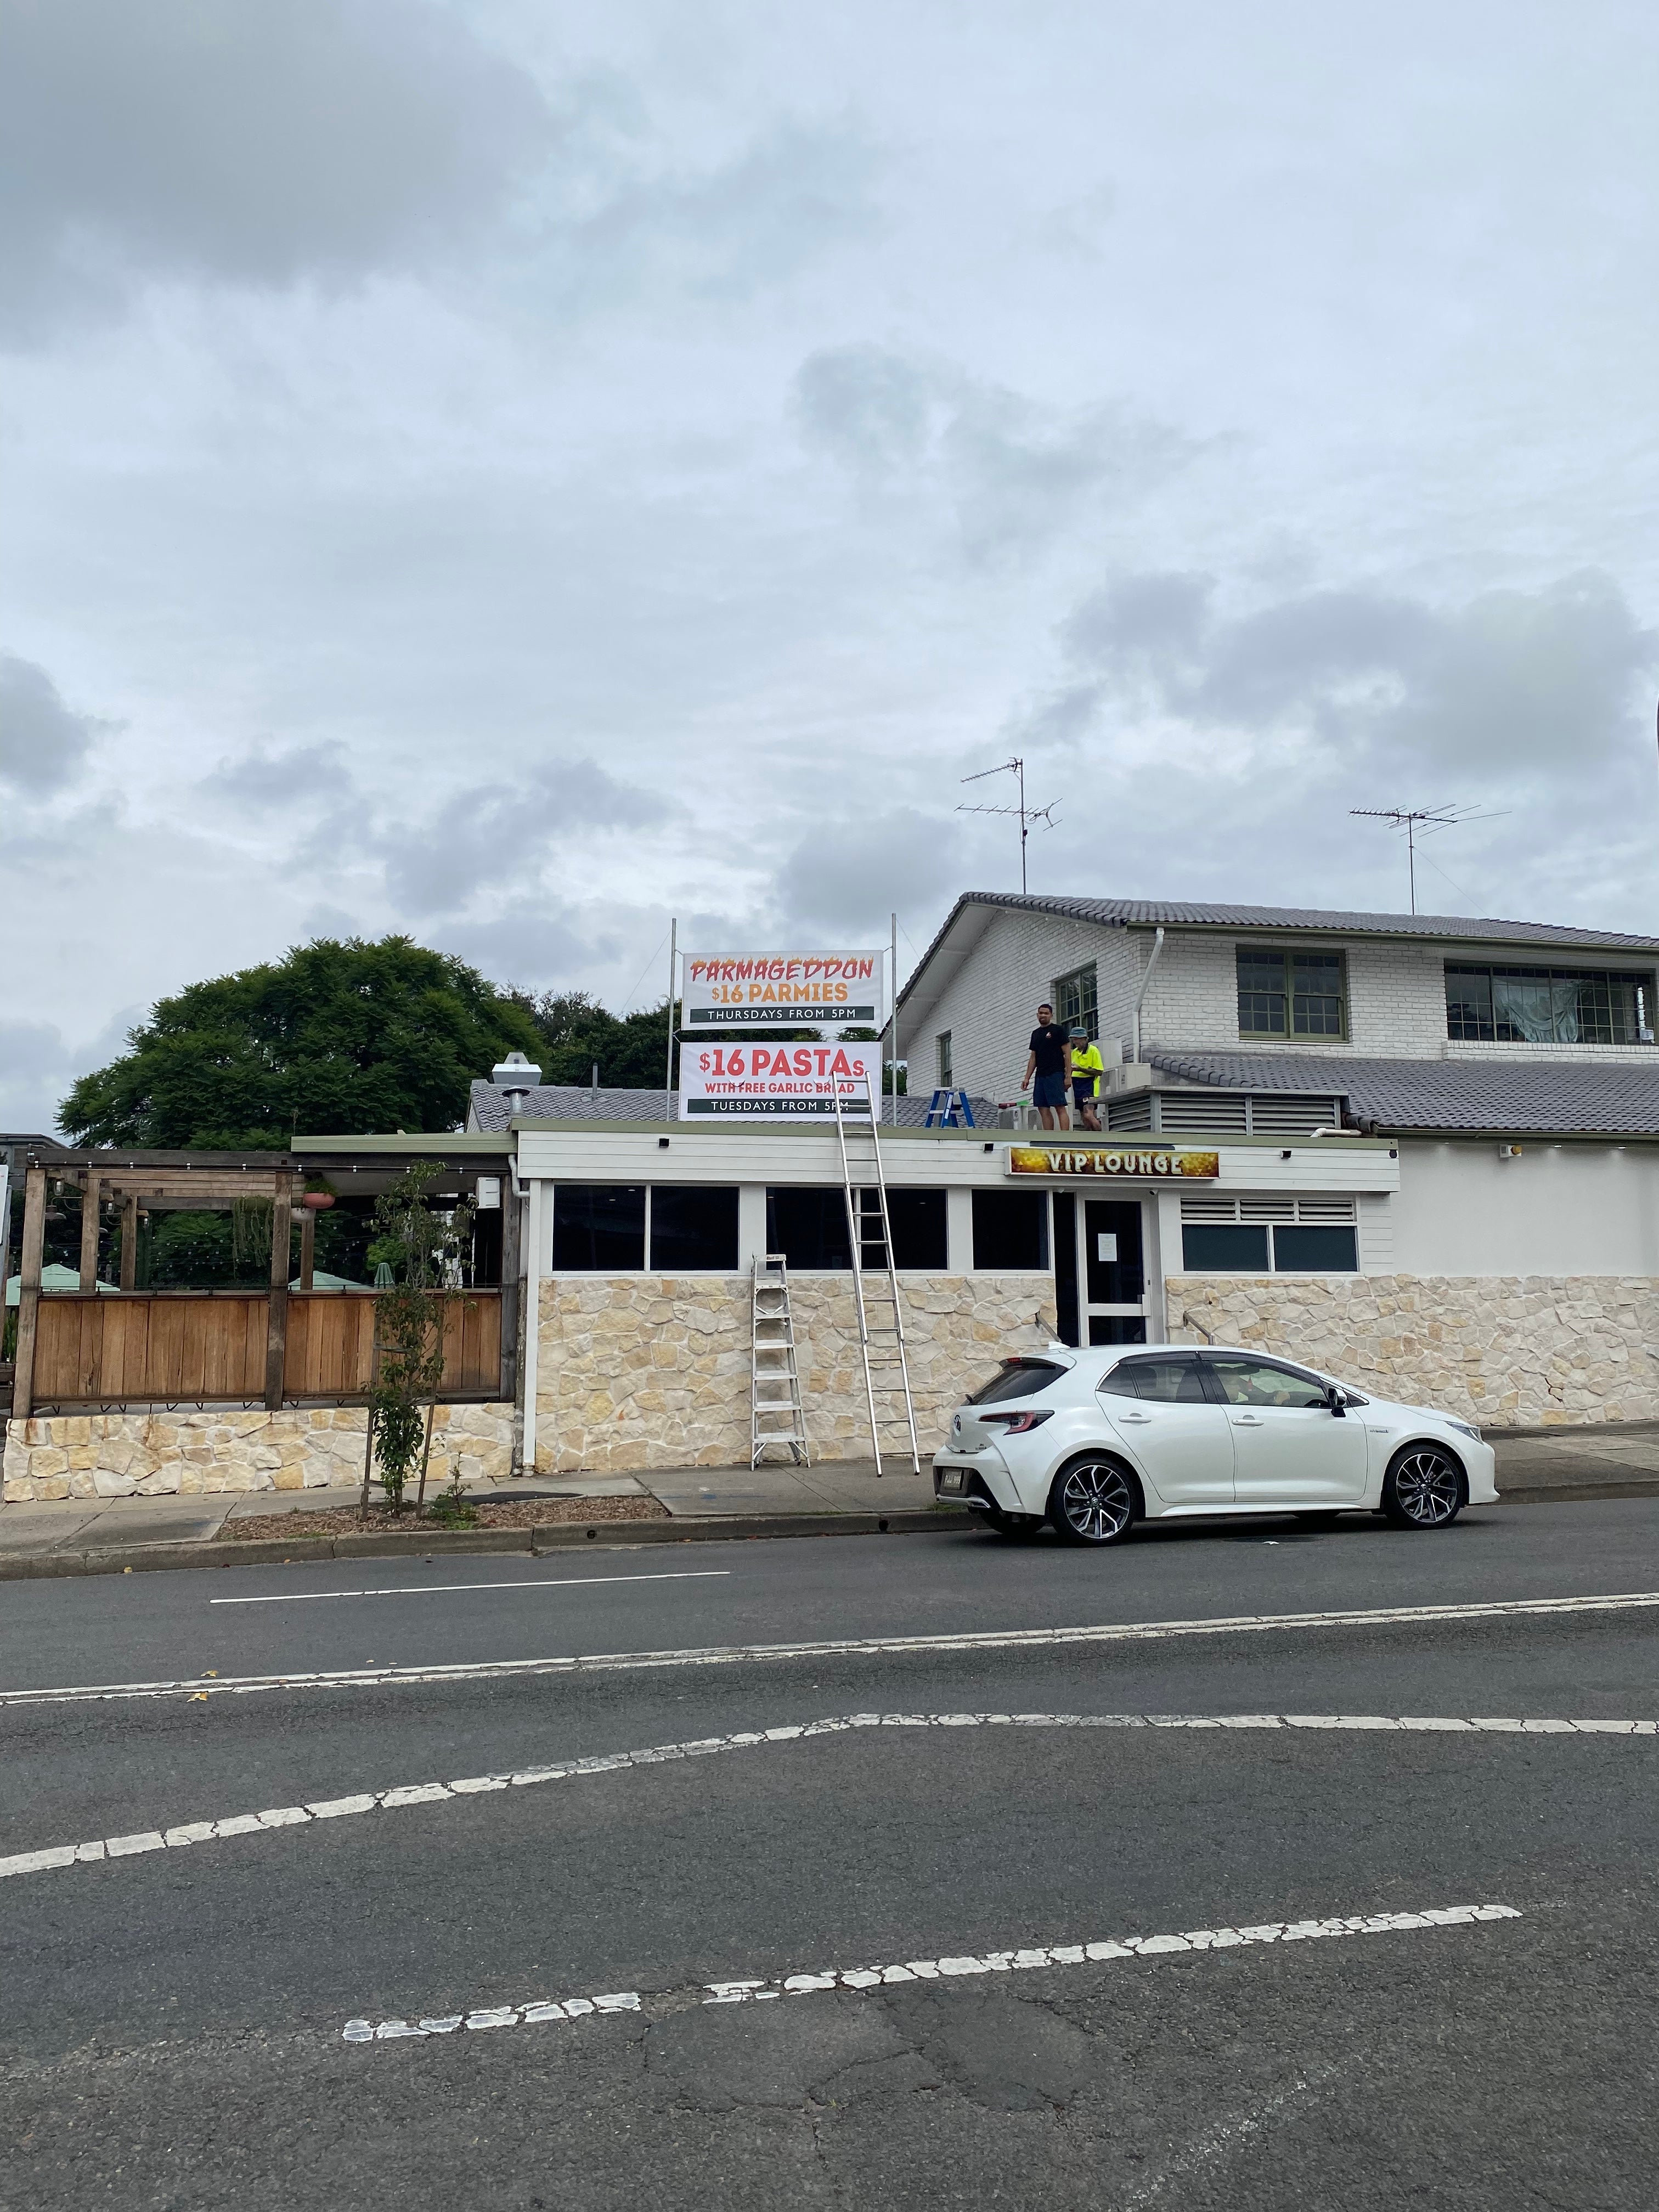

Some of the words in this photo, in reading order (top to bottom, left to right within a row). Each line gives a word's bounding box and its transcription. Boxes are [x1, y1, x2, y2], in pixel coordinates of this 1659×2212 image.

[690, 956, 873, 981] PARMAGEDDON
[712, 985, 743, 1003] $16
[749, 983, 848, 1002] PARMIES
[708, 1009, 783, 1020] THURSDAYS
[789, 1009, 824, 1018] FROM
[831, 1009, 856, 1018] 5PM
[699, 1049, 745, 1076] $16
[705, 1082, 735, 1093] WITH
[738, 1082, 765, 1093] FREE
[768, 1082, 813, 1093] GARLIC
[816, 1082, 855, 1093] BRAD
[710, 1101, 776, 1111] TUESDAYS
[782, 1101, 817, 1111] FROM
[1048, 1152, 1089, 1172] VIP
[1094, 1154, 1183, 1175] LOUNGE
